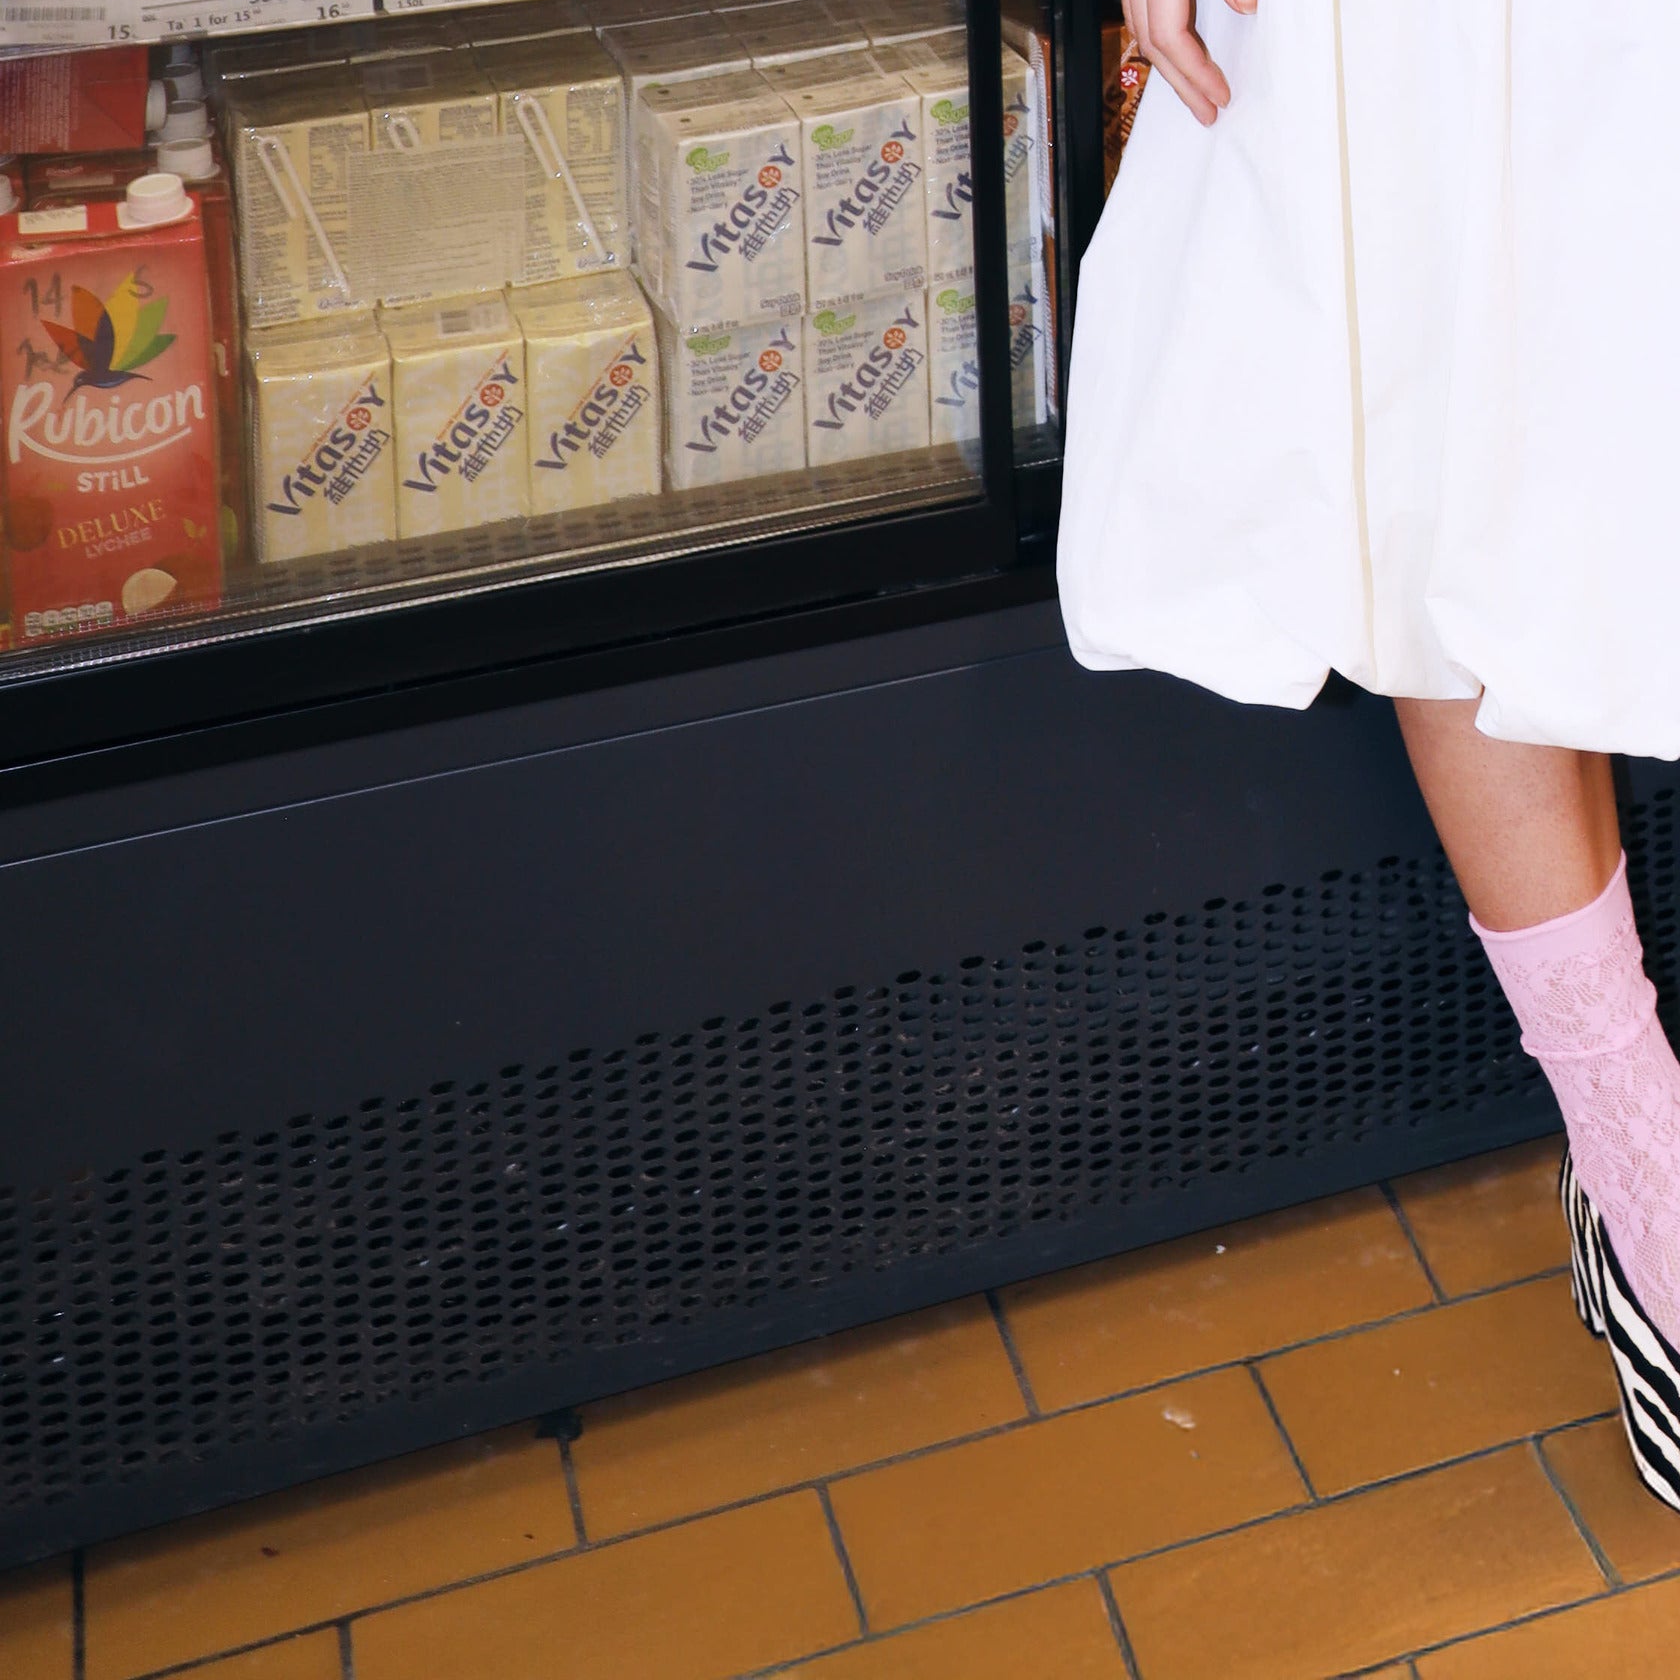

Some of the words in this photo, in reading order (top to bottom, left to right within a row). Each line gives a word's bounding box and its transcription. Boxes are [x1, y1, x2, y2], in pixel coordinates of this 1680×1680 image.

[108, 24, 131, 40] 15
[209, 13, 228, 27] for
[234, 10, 251, 22] 15
[317, 4, 340, 20] 16
[863, 348, 925, 420] 維他奶
[8, 382, 206, 465] Rubicon
[738, 371, 800, 443] 維他奶
[57, 498, 167, 549] DELUXE
[85, 527, 152, 559] LYCHEE
